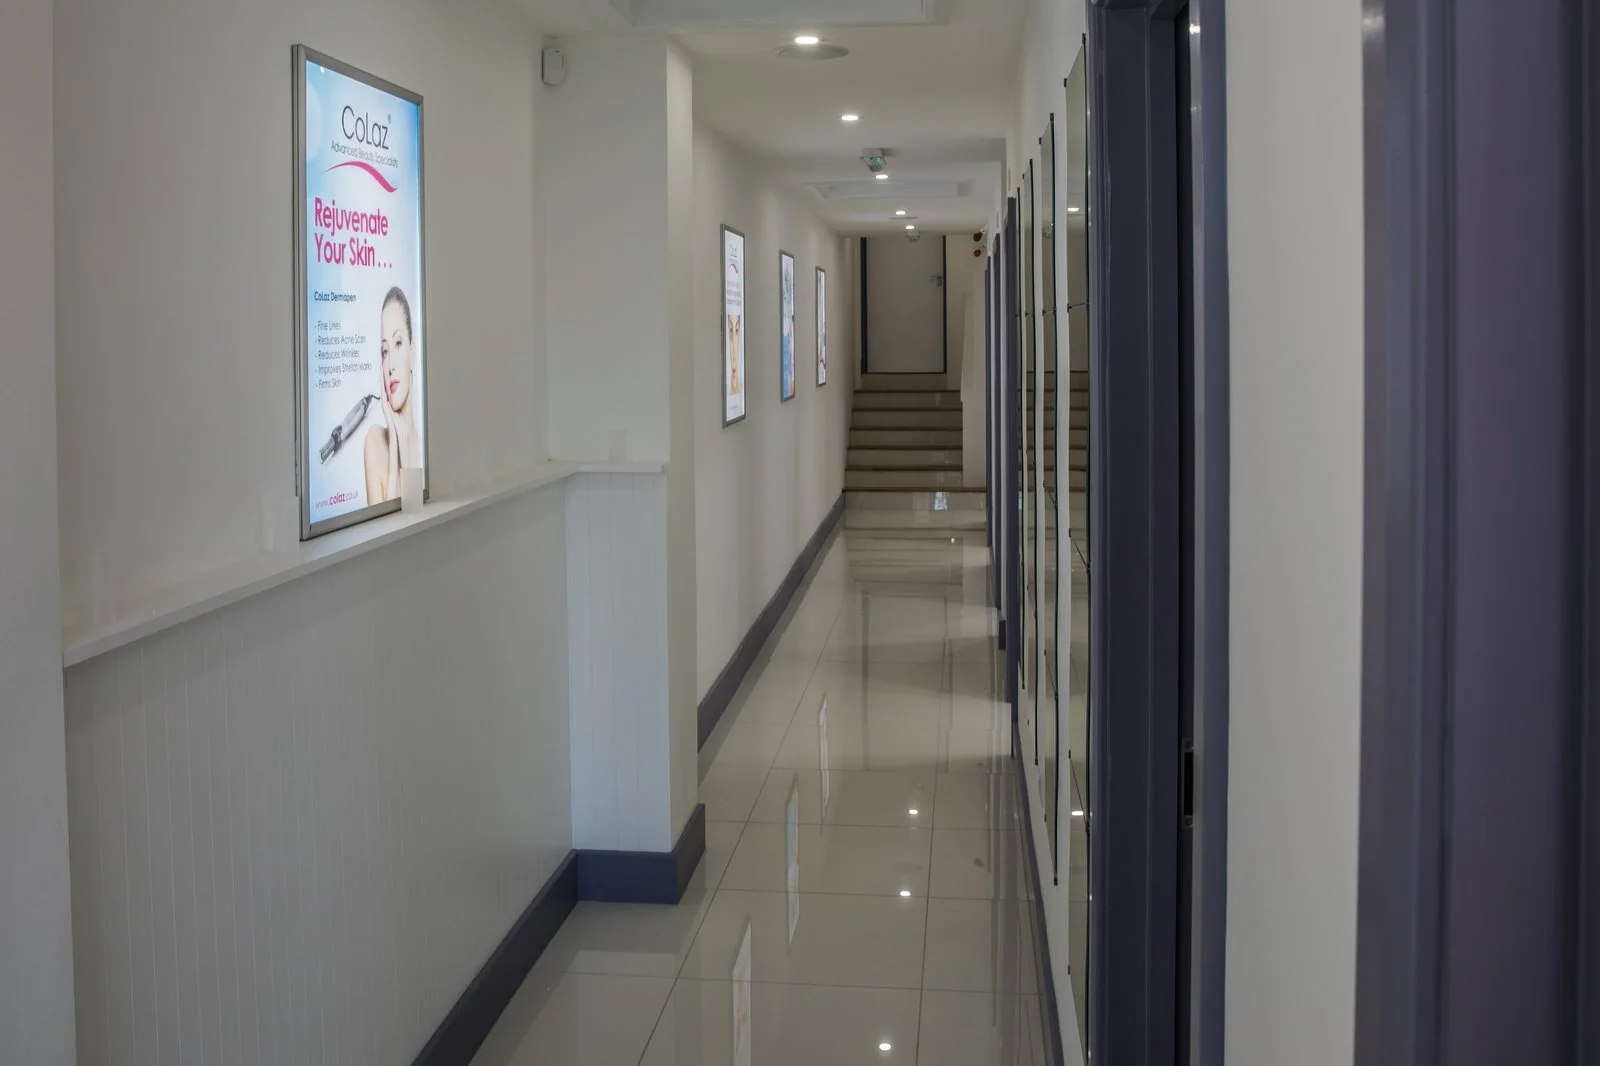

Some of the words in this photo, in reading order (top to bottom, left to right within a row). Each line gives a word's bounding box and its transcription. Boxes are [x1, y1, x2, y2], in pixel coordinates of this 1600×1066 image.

[341, 105, 389, 150] CoLaz
[314, 197, 389, 236] Rejuvenate
[314, 232, 346, 264] Your
[331, 291, 357, 304] Dermapen
[317, 320, 328, 331] Fine
[329, 320, 341, 331] Lines
[317, 335, 340, 345] Reduces
[341, 335, 355, 344] Acne
[318, 350, 340, 360] Reduces
[341, 349, 360, 358] Wrinkles
[318, 364, 341, 375] Improves
[342, 362, 358, 372] Stretch
[318, 379, 331, 389] Firms
[332, 377, 342, 388] Skin
